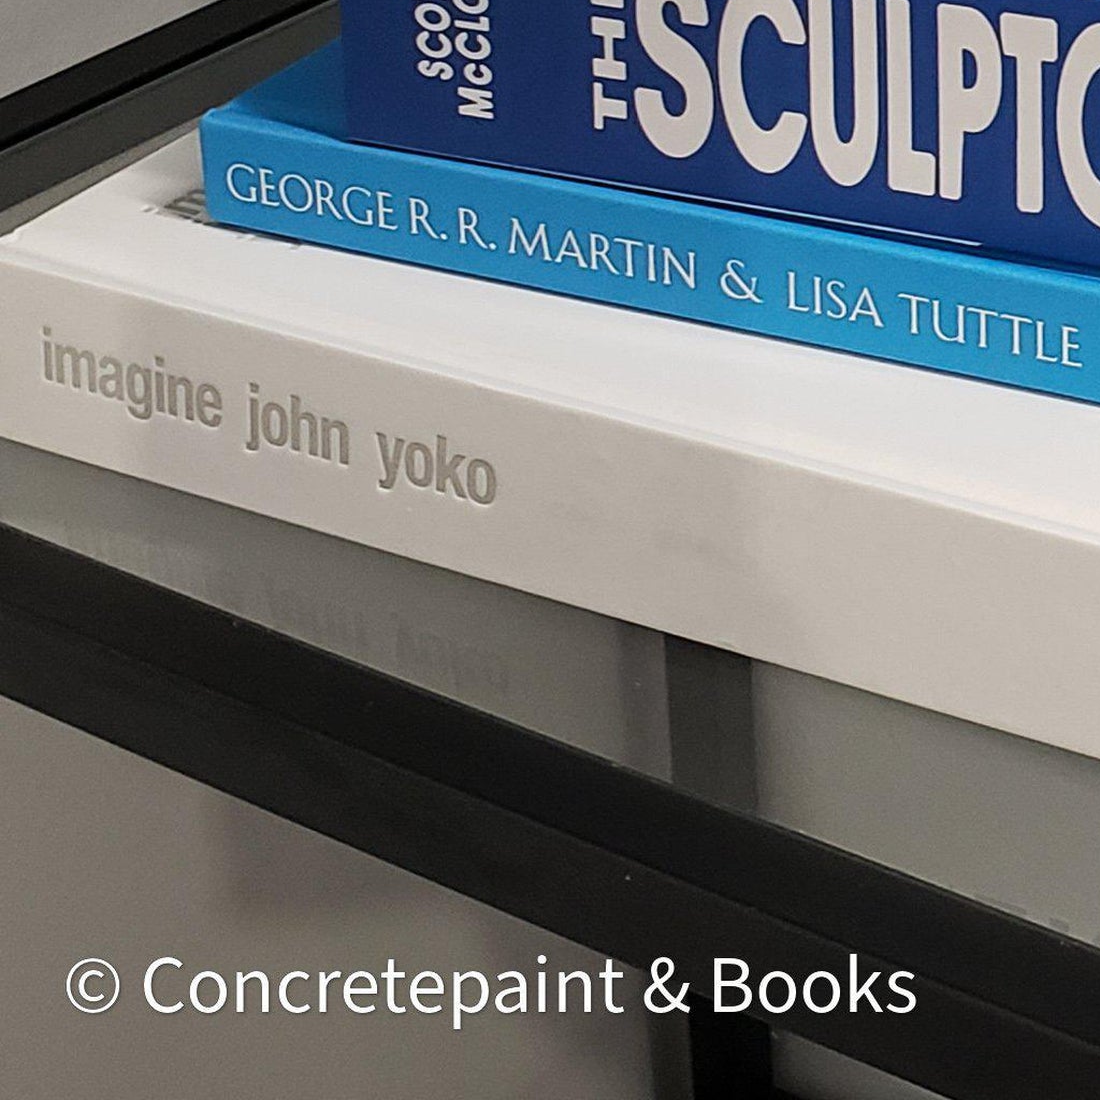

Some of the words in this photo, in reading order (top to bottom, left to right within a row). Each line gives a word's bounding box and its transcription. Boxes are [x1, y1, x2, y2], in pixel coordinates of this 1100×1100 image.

[226, 164, 399, 230] GEORGE
[408, 198, 449, 241] R.
[457, 207, 498, 251] R.
[508, 218, 697, 290] MARTIN
[720, 260, 764, 304] &
[786, 271, 884, 328] LISA
[897, 293, 1083, 368] TUTTLE
[41, 326, 224, 429] imagine
[245, 382, 351, 466] john
[375, 432, 497, 506] yoko
